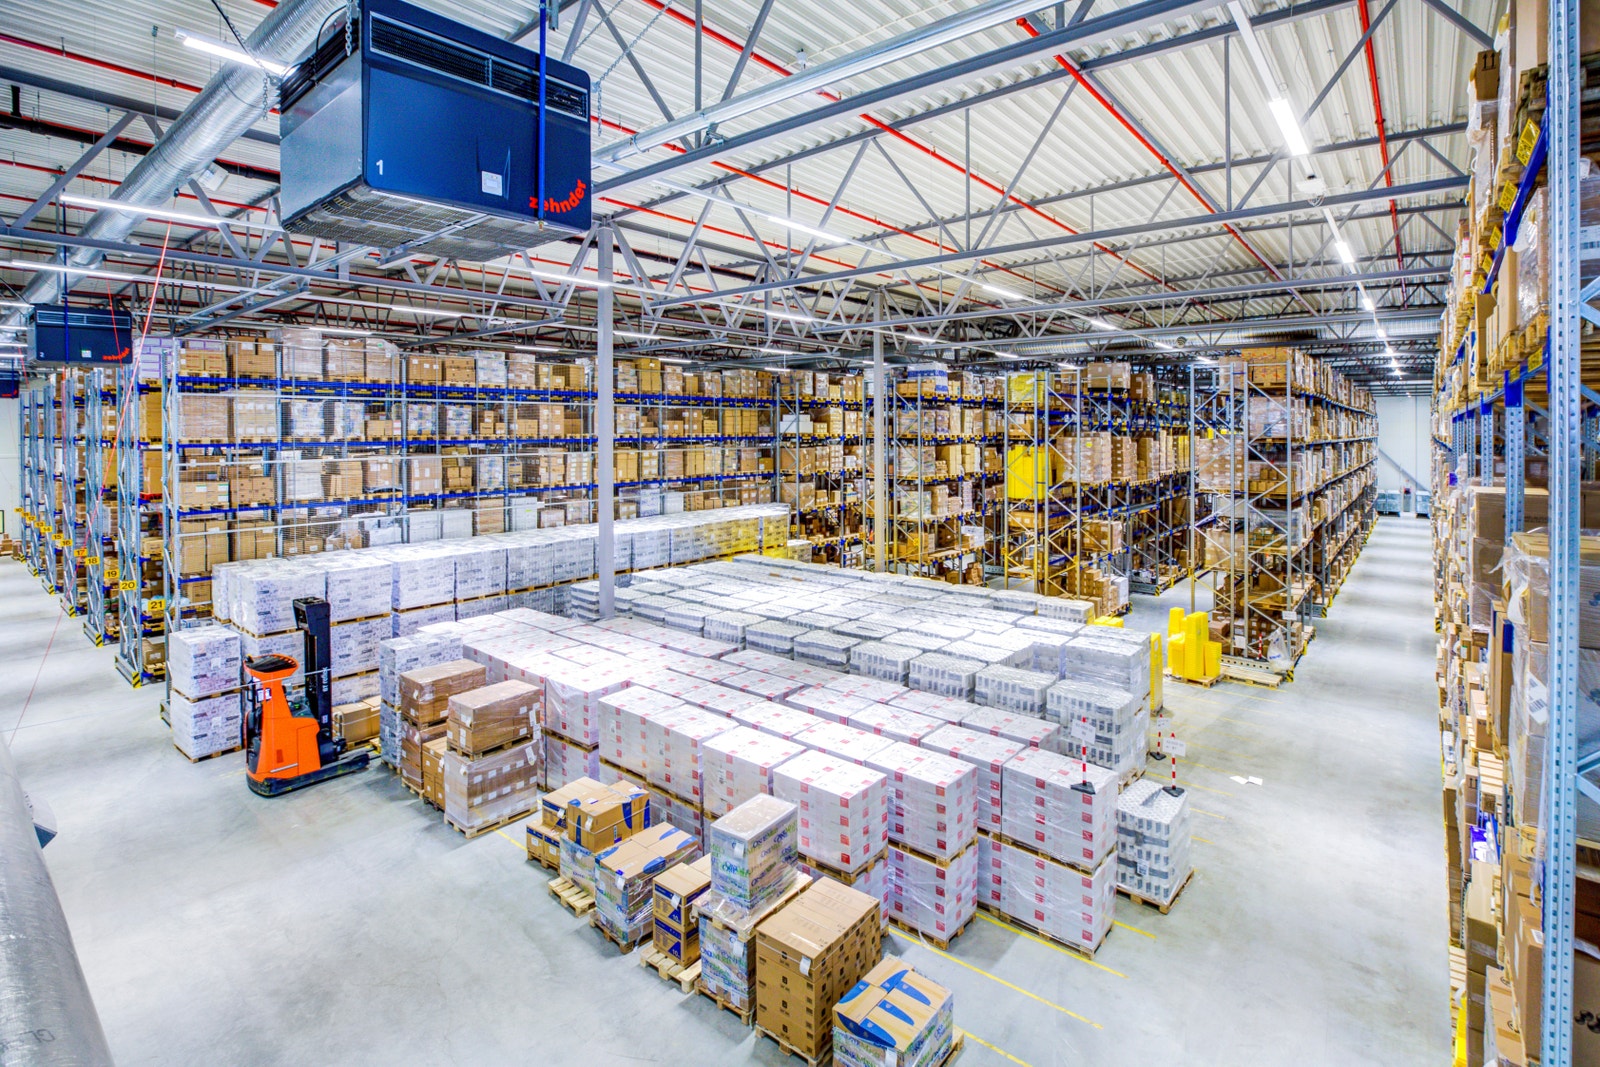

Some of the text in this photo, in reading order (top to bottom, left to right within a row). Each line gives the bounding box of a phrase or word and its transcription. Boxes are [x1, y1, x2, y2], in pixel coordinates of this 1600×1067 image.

[376, 160, 384, 175] 1
[122, 581, 135, 589] 20
[150, 600, 163, 609] 21
